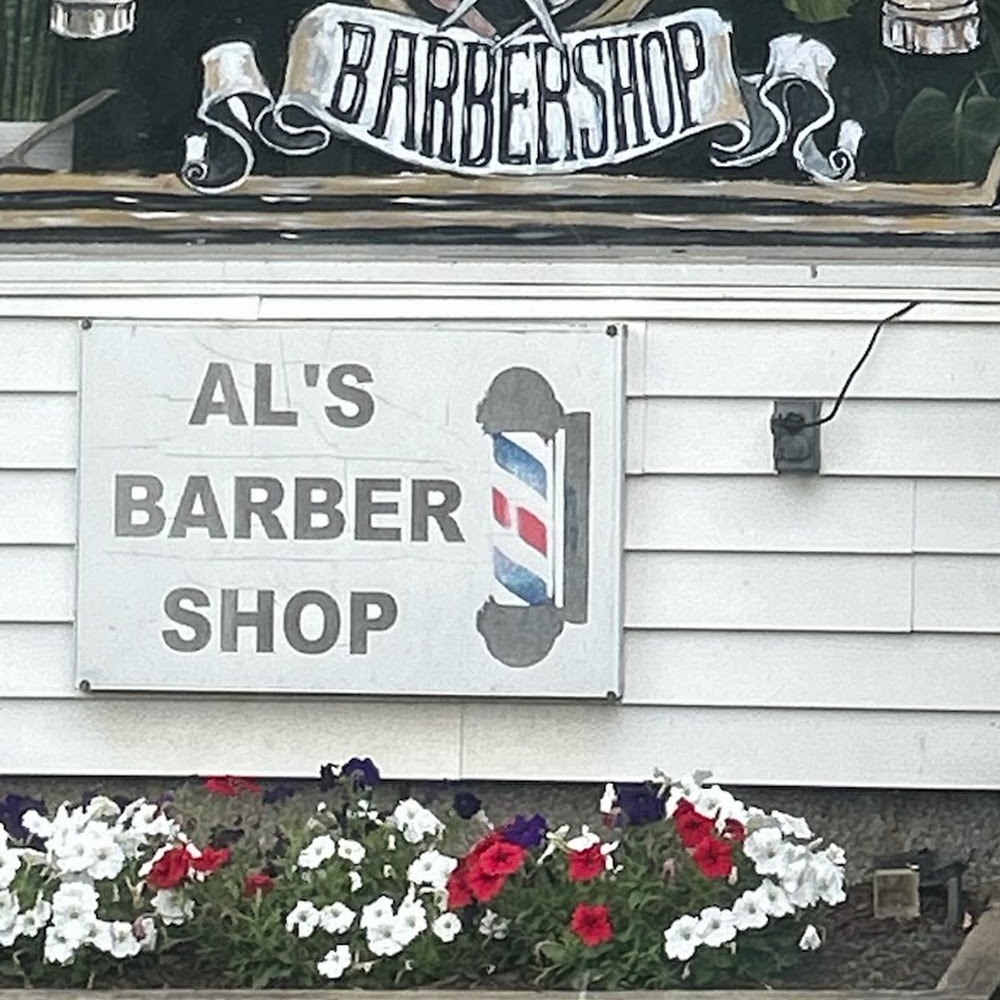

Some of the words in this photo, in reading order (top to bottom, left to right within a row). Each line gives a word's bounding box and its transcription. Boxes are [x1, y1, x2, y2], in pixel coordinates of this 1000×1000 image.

[326, 21, 707, 168] BARBERSHOP
[188, 362, 376, 429] AL'S
[114, 473, 466, 543] BARBER
[161, 587, 399, 655] SHOP
